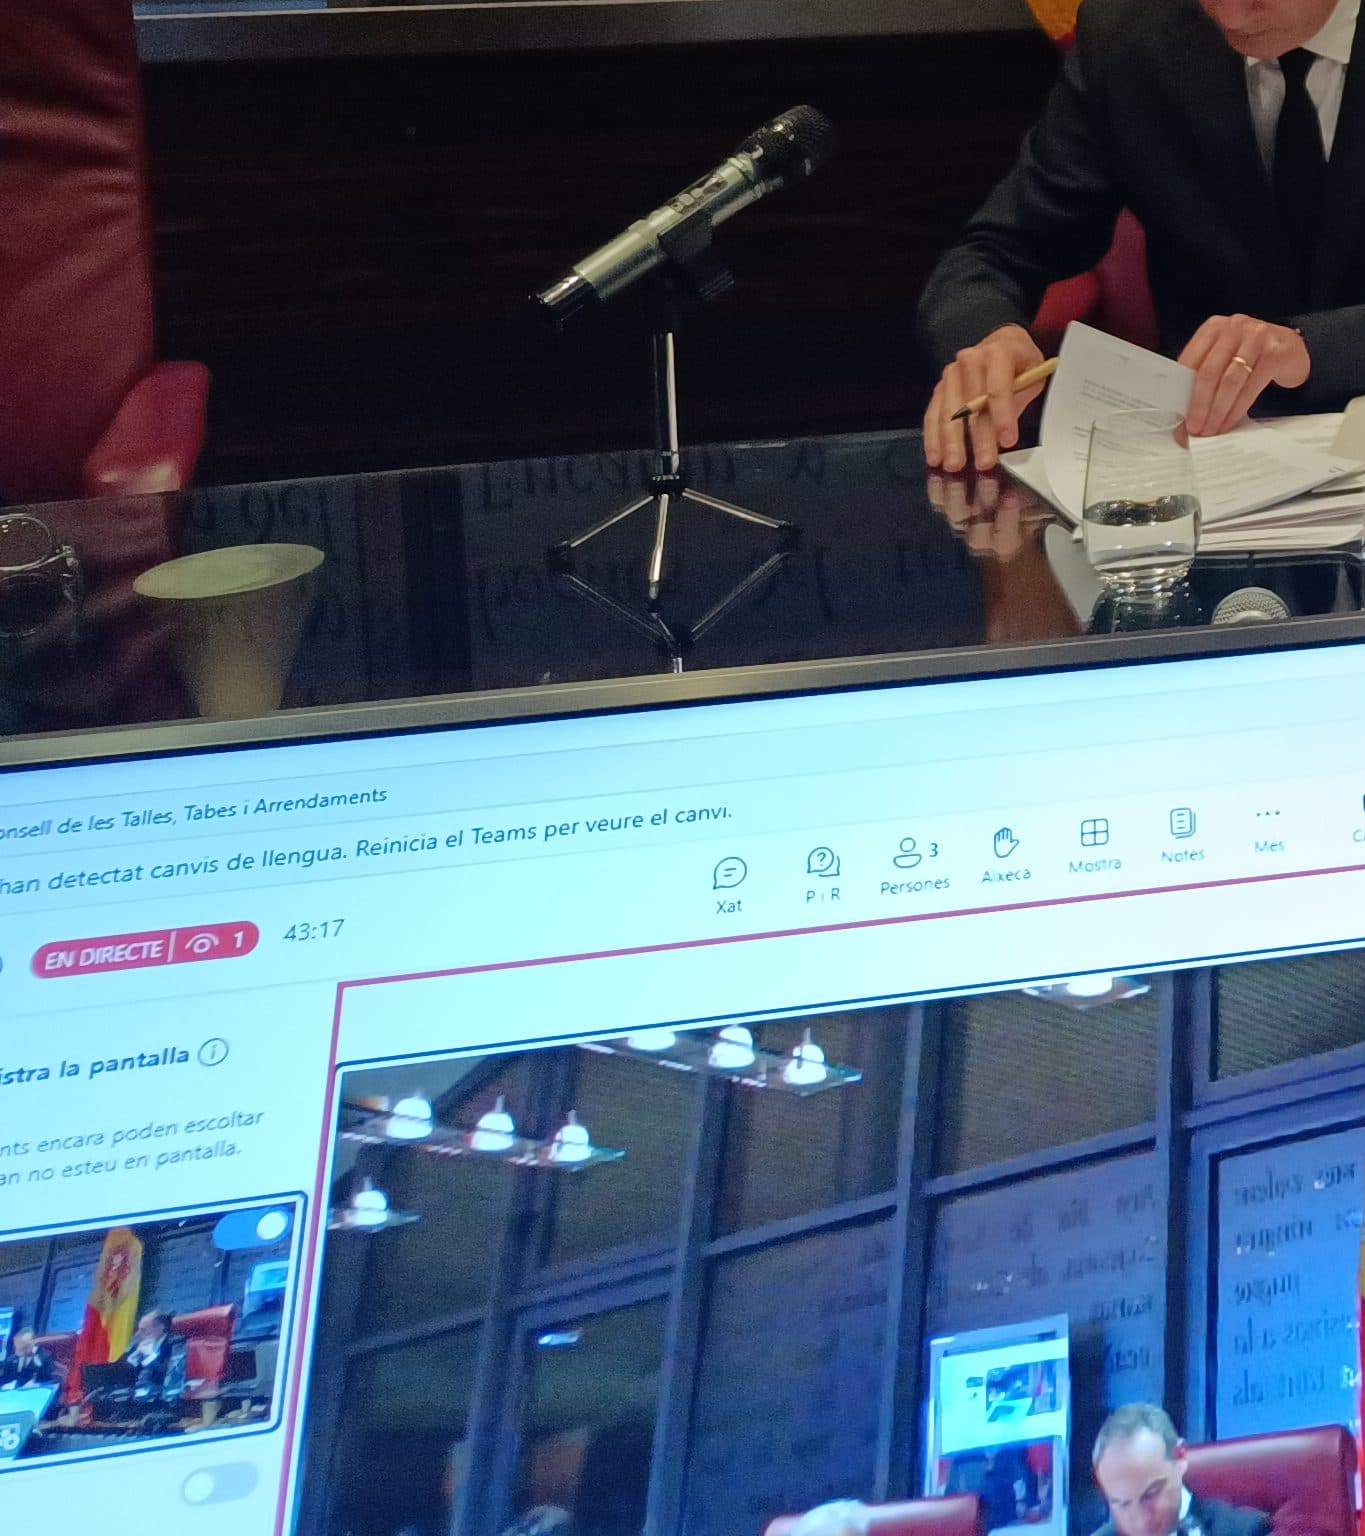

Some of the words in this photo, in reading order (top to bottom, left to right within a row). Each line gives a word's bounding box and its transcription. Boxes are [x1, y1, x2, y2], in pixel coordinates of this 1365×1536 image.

[0, 818, 51, 841] onsell
[57, 814, 82, 835] de
[87, 812, 116, 833] les
[121, 809, 179, 828] Talles,
[184, 802, 238, 822] Tabes
[242, 799, 250, 816] i
[252, 787, 389, 816] Arrendaments
[47, 865, 145, 892] detectat
[150, 856, 220, 880] canvis
[226, 853, 256, 872] de
[260, 845, 349, 869] llengua.
[355, 833, 439, 857] Reinicia
[444, 829, 464, 848] el
[471, 825, 538, 845] Teams
[543, 820, 581, 842] per
[584, 815, 645, 832] veure
[649, 808, 668, 826] el
[673, 801, 734, 824] canvi.
[928, 841, 941, 859] 3
[1160, 848, 1207, 865] Notes
[1067, 857, 1123, 875] Mostra
[805, 890, 818, 904] P
[830, 887, 842, 902] R
[880, 876, 951, 897] Persones
[715, 899, 744, 915] Xat
[282, 918, 347, 944] 43:17
[43, 950, 75, 971] EN
[78, 938, 166, 967] DIRECTE
[232, 929, 246, 949] 1
[0, 1066, 51, 1086] istra
[57, 1060, 82, 1080] la
[87, 1046, 191, 1081] pantalla
[0, 1141, 30, 1159] nts
[36, 1130, 106, 1154] encara
[110, 1120, 179, 1148] poden
[182, 1109, 266, 1135] escoltar
[27, 1168, 56, 1184] no
[60, 1158, 119, 1179] esteu
[123, 1153, 151, 1171] en
[153, 1139, 243, 1172] pantalla.
